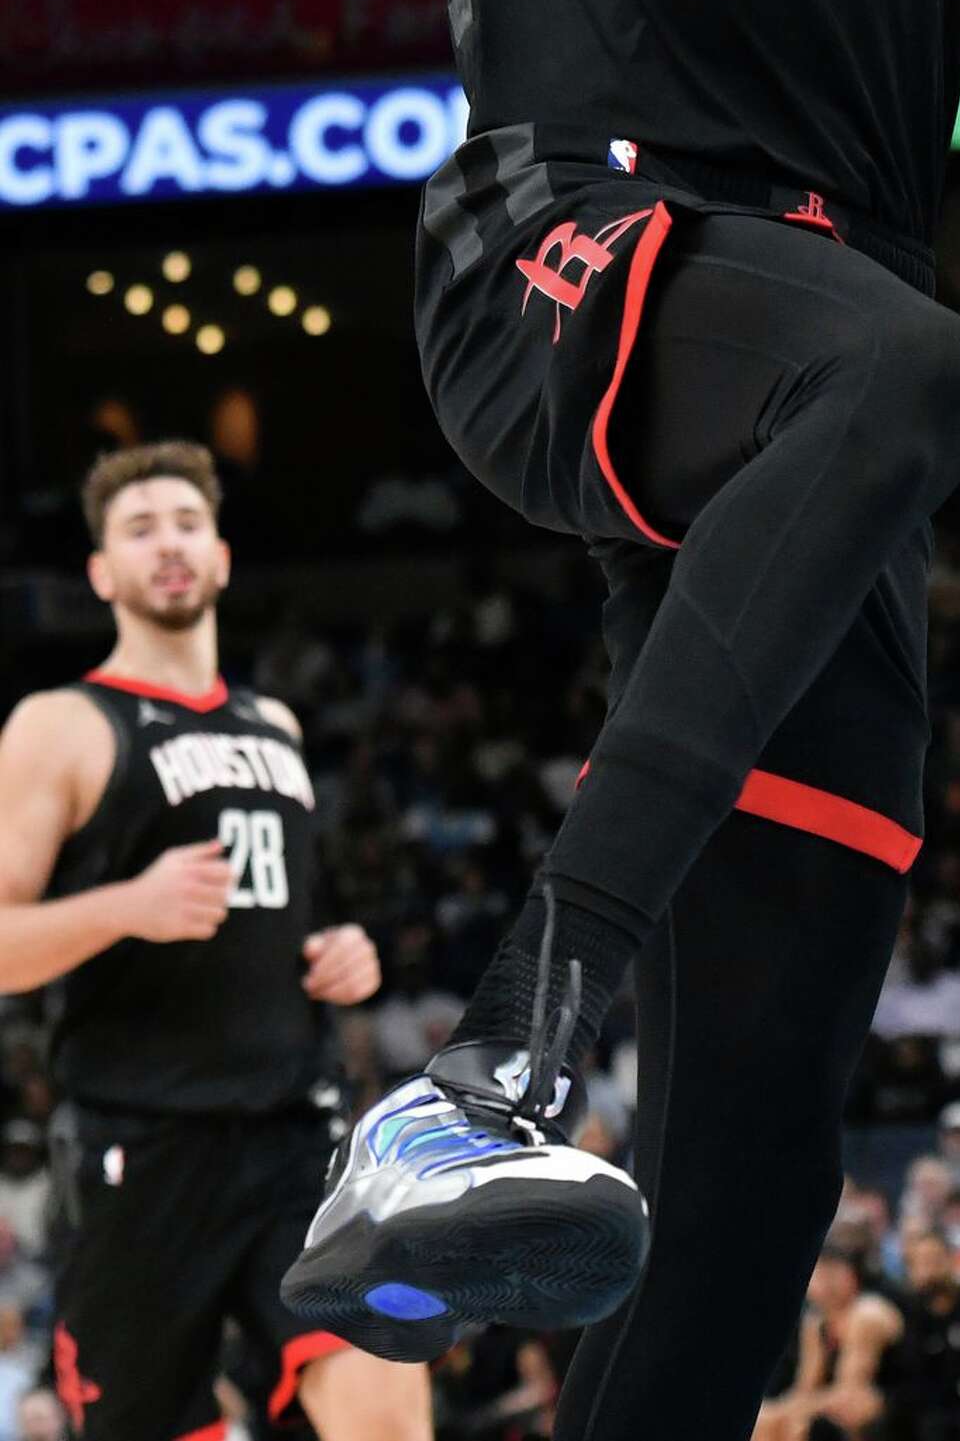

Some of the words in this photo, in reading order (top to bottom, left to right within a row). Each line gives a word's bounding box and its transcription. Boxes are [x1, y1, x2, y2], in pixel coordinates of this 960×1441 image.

[0, 86, 468, 205] CPAS.CO
[150, 733, 315, 810] HOUSTON
[218, 809, 288, 908] 28
